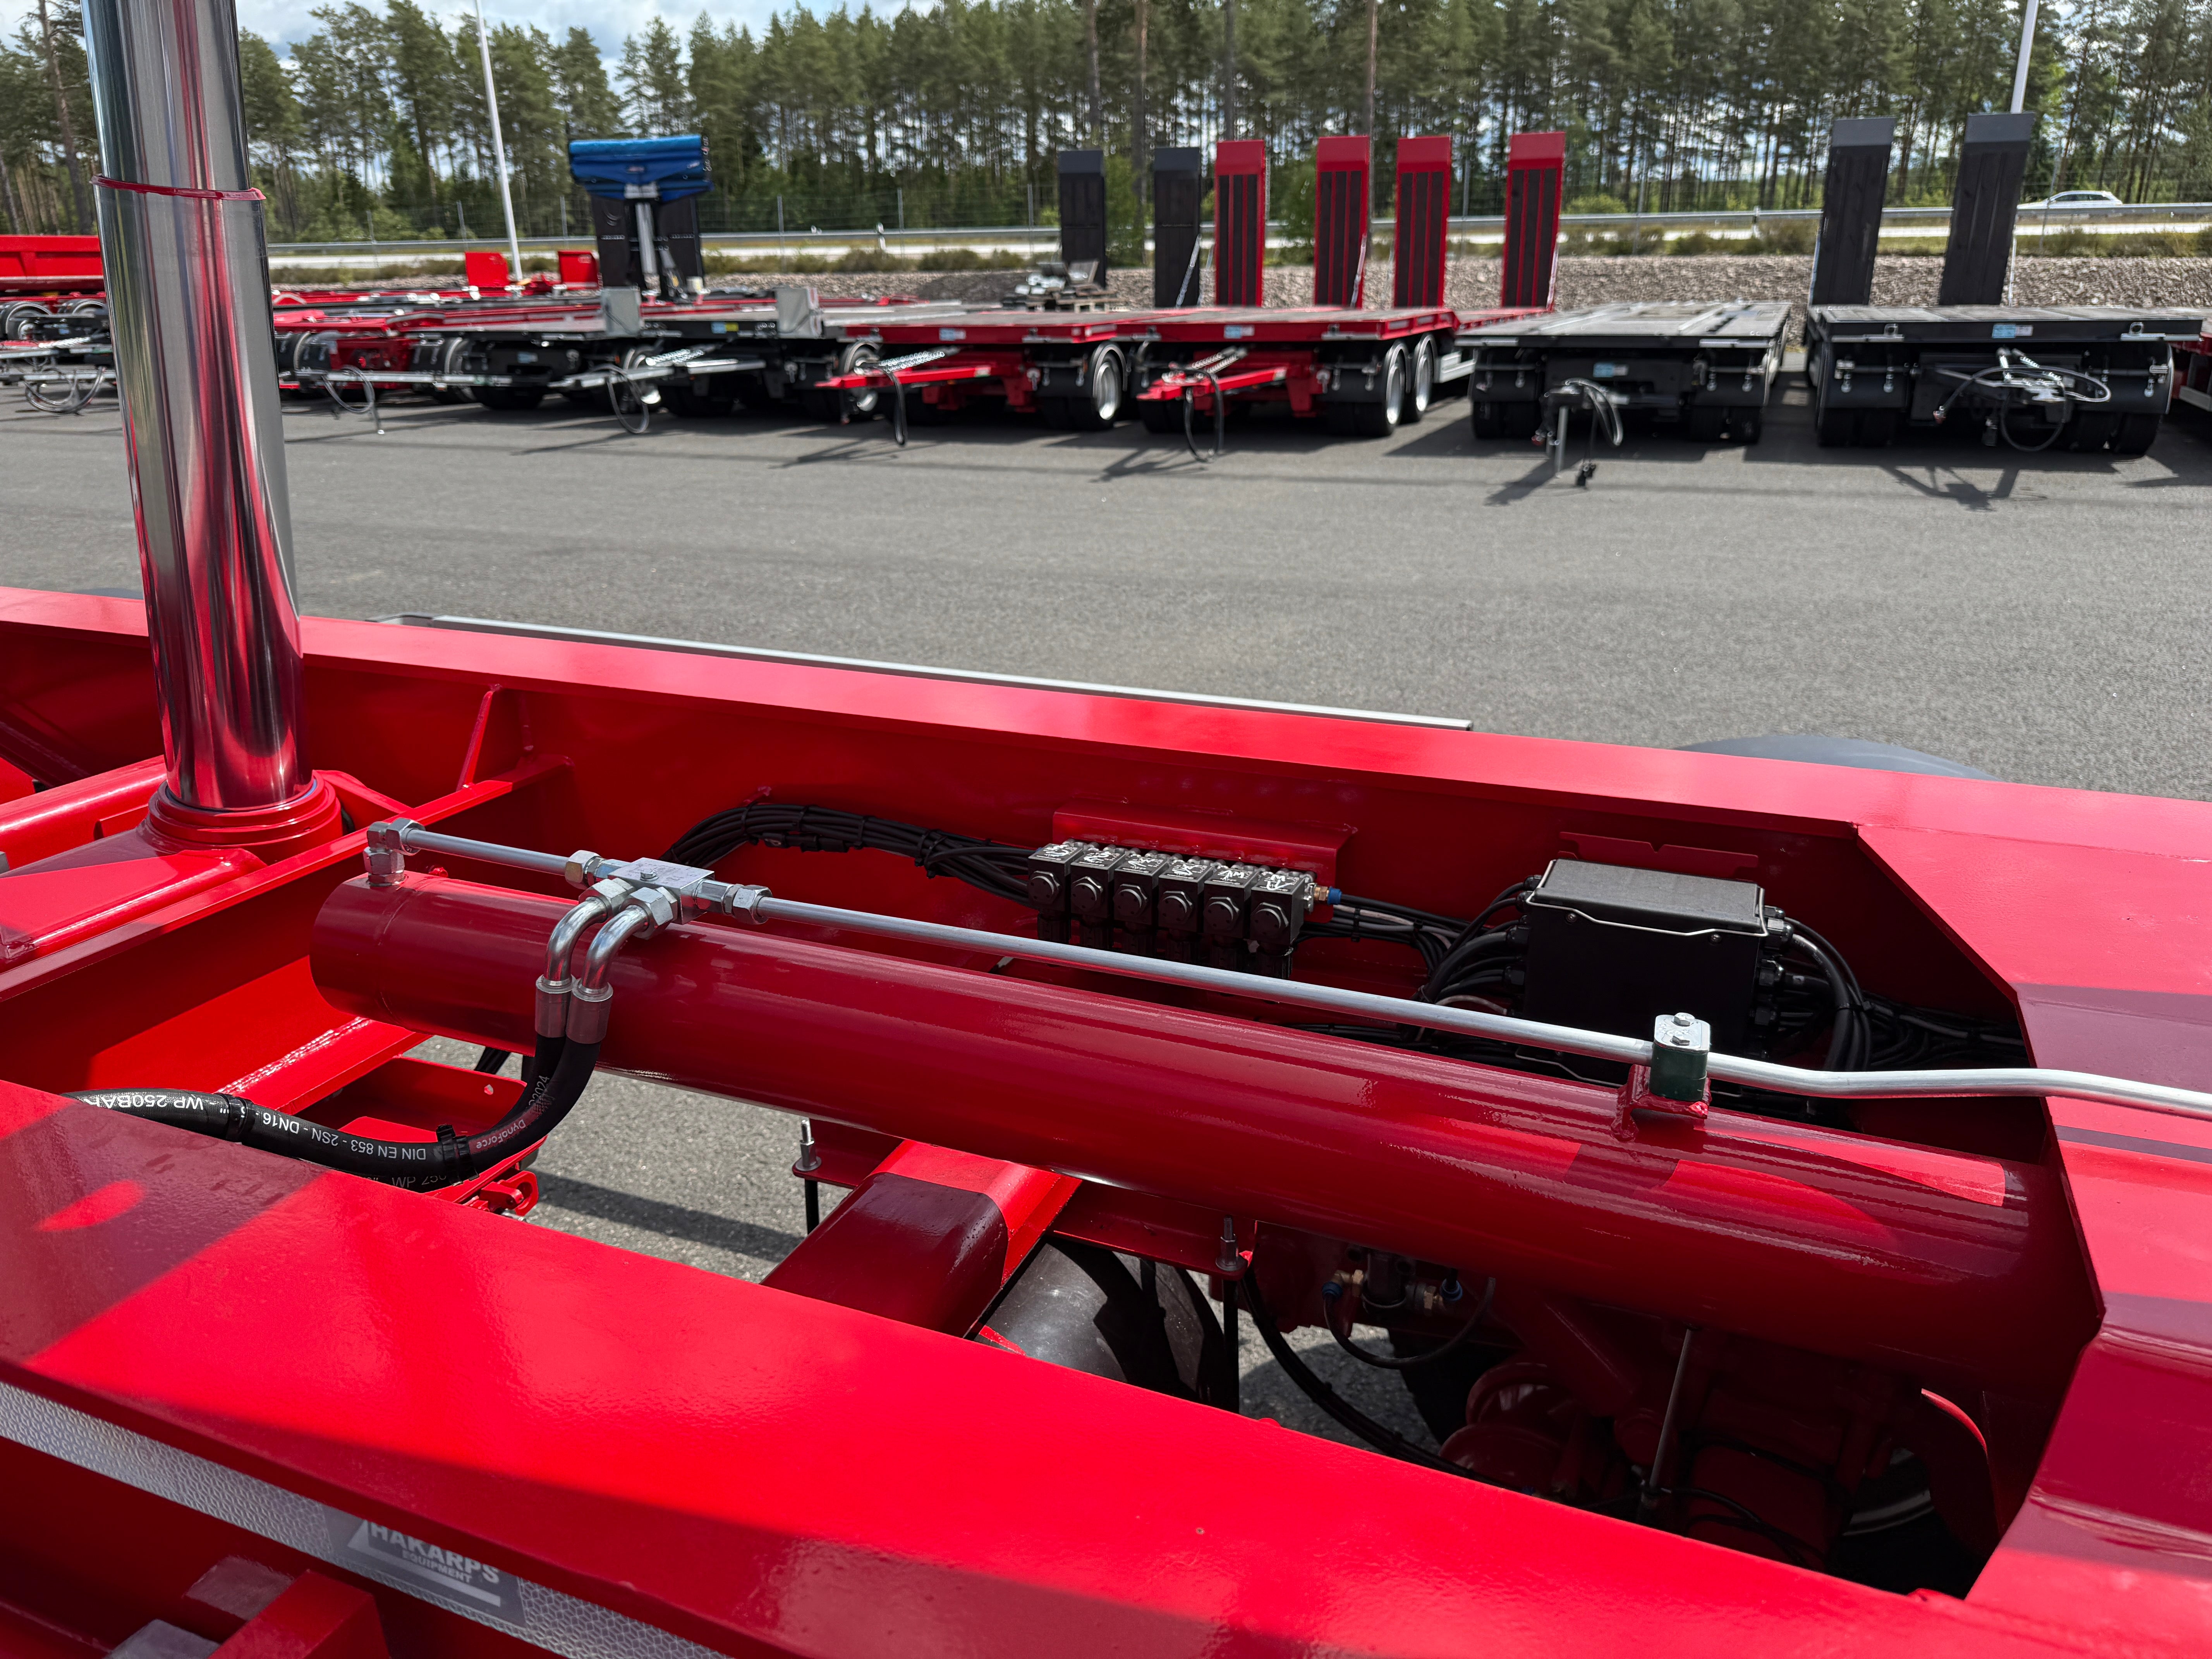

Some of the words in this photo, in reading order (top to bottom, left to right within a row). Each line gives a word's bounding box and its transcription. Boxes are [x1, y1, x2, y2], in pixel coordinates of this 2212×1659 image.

[173, 1095, 204, 1111] WP
[263, 1112, 299, 1134] DN16
[311, 1128, 339, 1146] 2SN
[476, 1119, 526, 1149] DynaForce
[351, 1140, 374, 1155] 853
[378, 1145, 397, 1159] EN
[402, 1148, 426, 1160] DIN
[392, 1176, 416, 1188] WP
[370, 1522, 500, 1584] HAKARPS
[402, 1549, 472, 1583] EQUIPMENT
